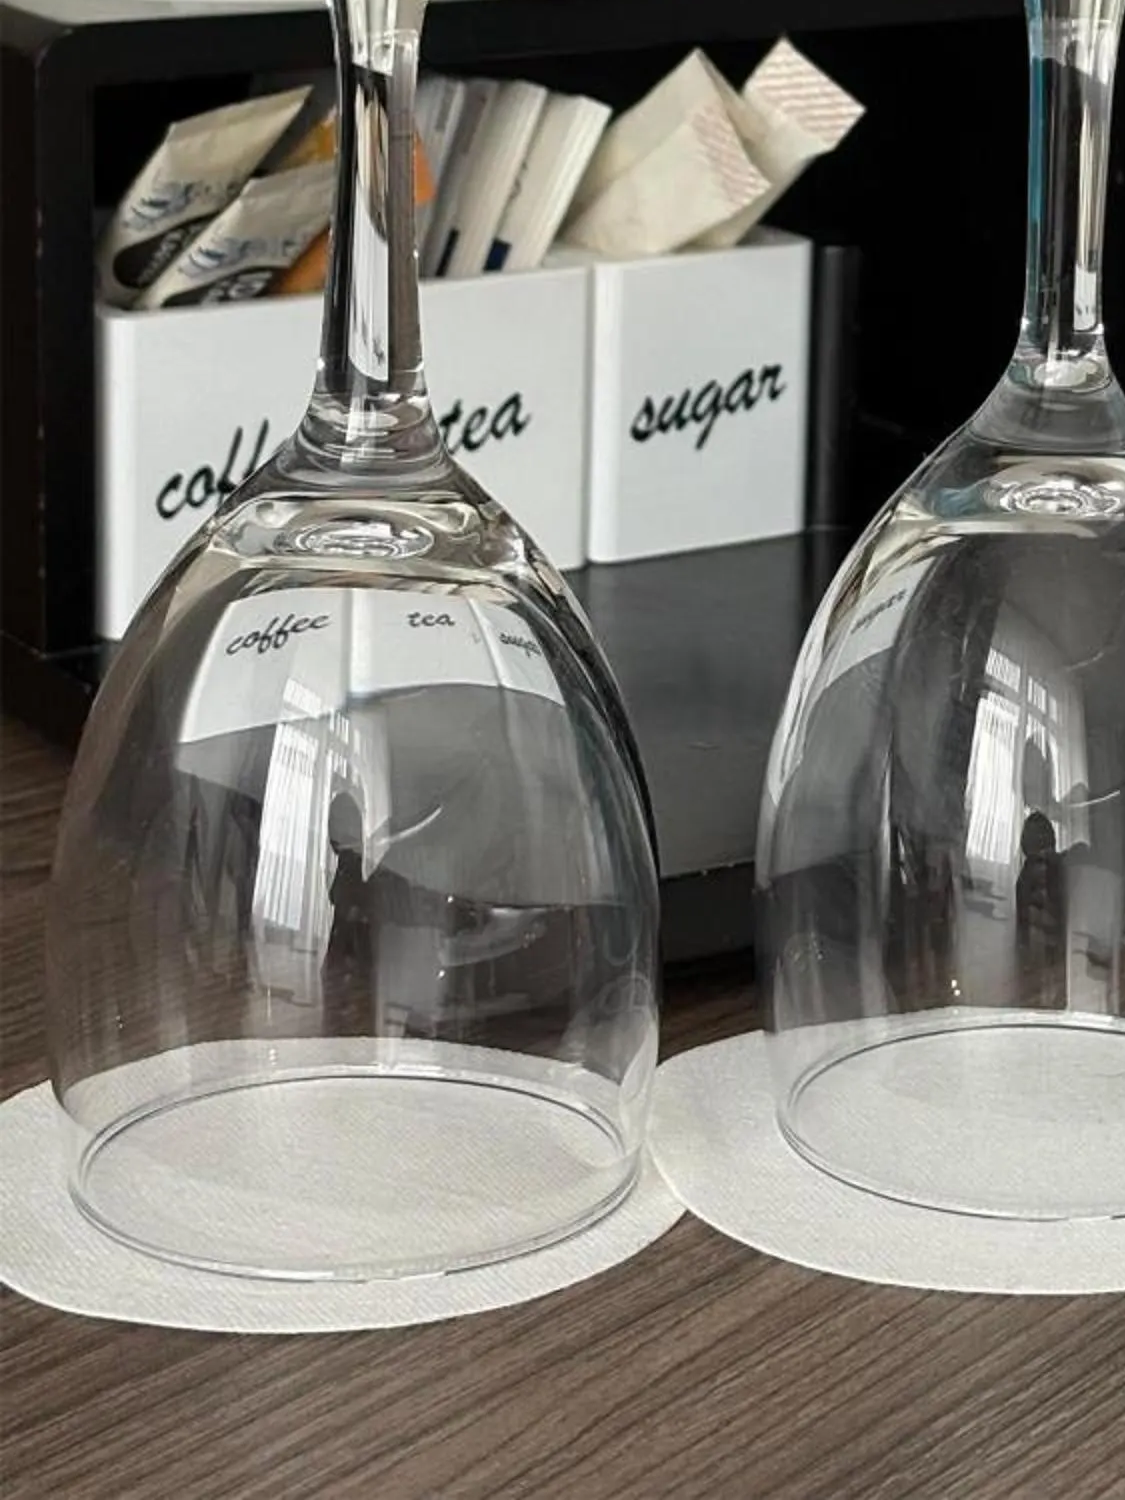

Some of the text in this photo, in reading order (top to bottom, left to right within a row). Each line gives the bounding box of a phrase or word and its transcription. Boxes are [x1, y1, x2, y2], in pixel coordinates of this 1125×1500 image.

[439, 393, 531, 453] tea
[630, 364, 787, 451] sugar
[156, 419, 270, 519] coff
